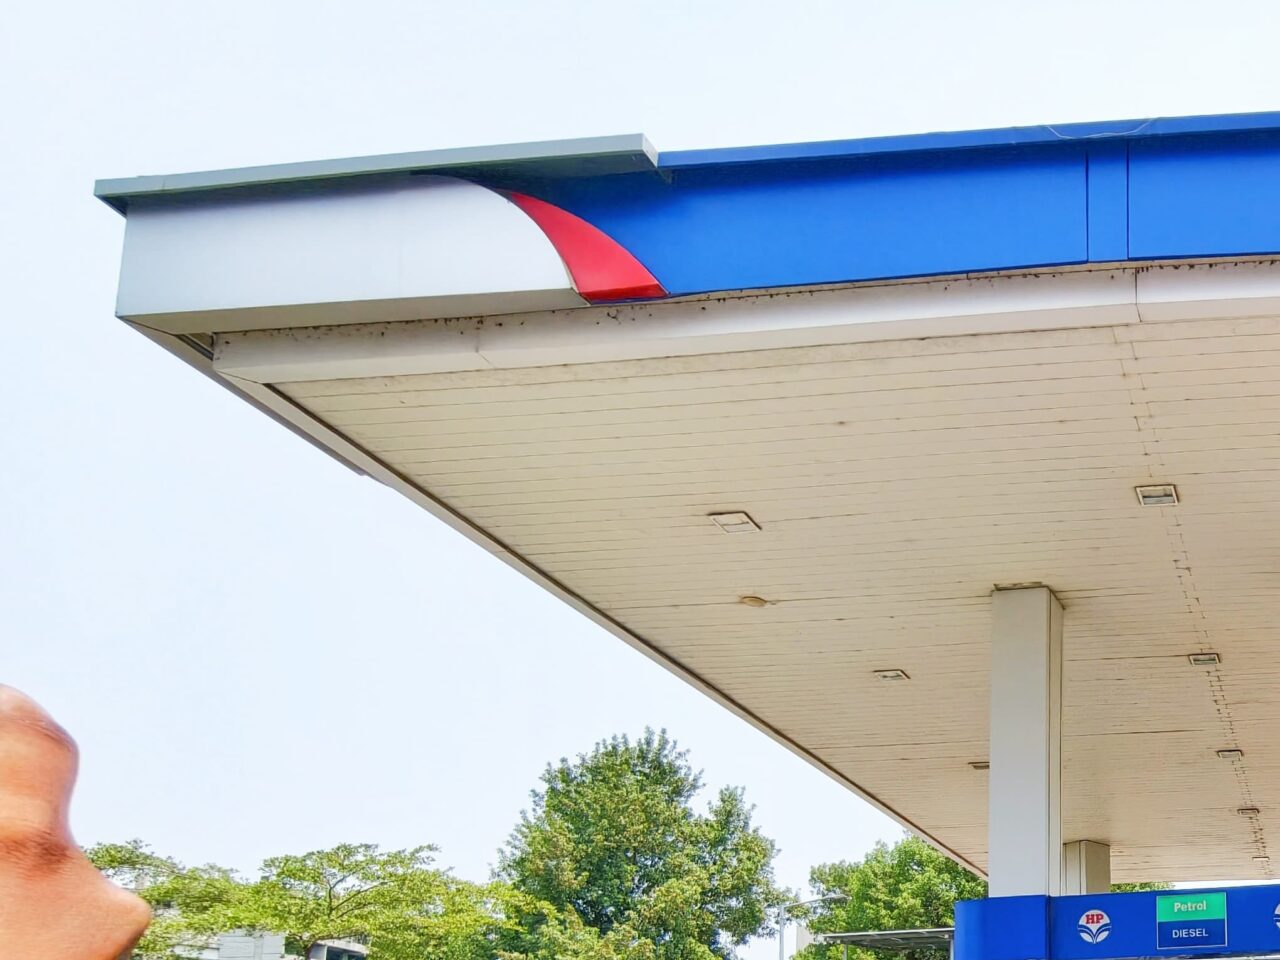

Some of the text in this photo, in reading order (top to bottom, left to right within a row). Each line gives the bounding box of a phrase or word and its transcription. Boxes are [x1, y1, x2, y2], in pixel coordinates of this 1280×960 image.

[1173, 900, 1207, 912] Petrol
[1085, 913, 1104, 925] HP
[1172, 928, 1208, 939] DIESEL
